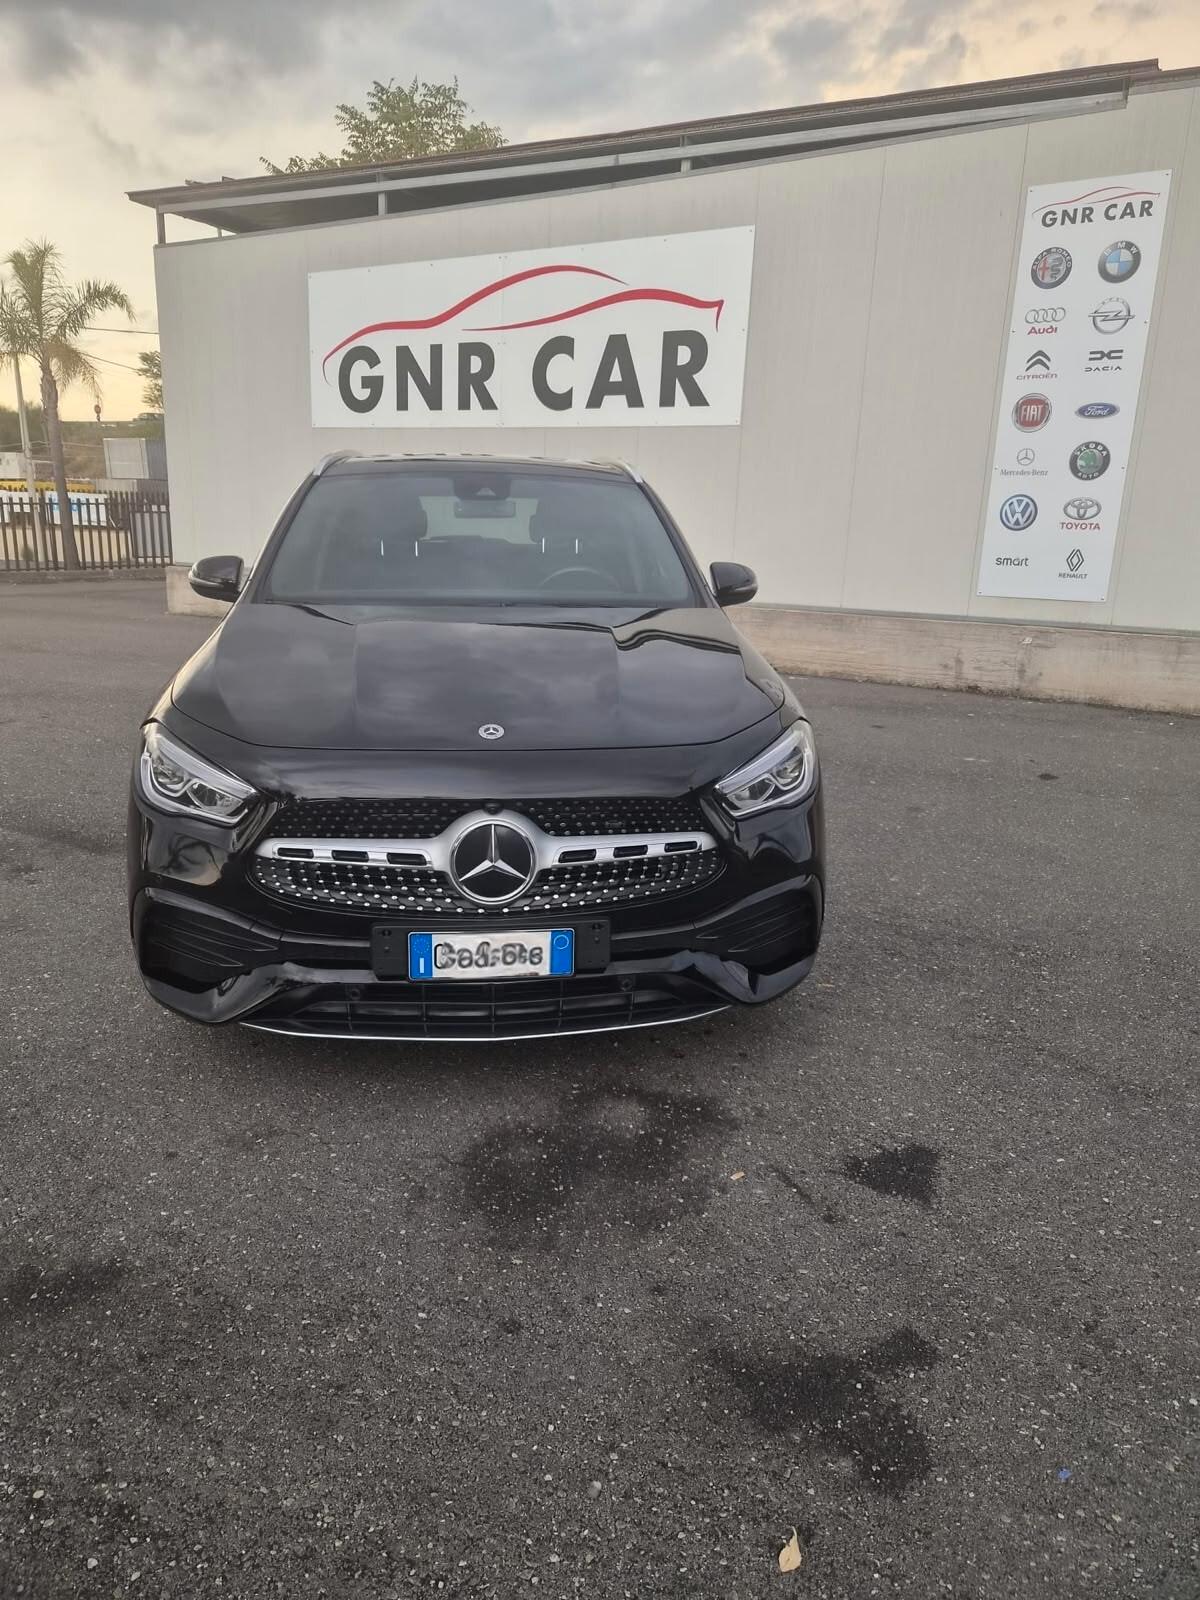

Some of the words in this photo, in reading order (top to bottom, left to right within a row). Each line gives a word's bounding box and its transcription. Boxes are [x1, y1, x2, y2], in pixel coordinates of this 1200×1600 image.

[1041, 206, 1095, 228] GNR
[1103, 200, 1154, 221] CAR
[1027, 326, 1058, 335] Audi
[338, 341, 499, 414] GNR
[532, 329, 710, 412] CAR
[1021, 405, 1043, 422] FIAT
[1084, 405, 1109, 416] Ford
[1000, 469, 1048, 477] Mercedes-Benz
[1059, 522, 1101, 530] TOYOTA
[995, 557, 1030, 567] smart
